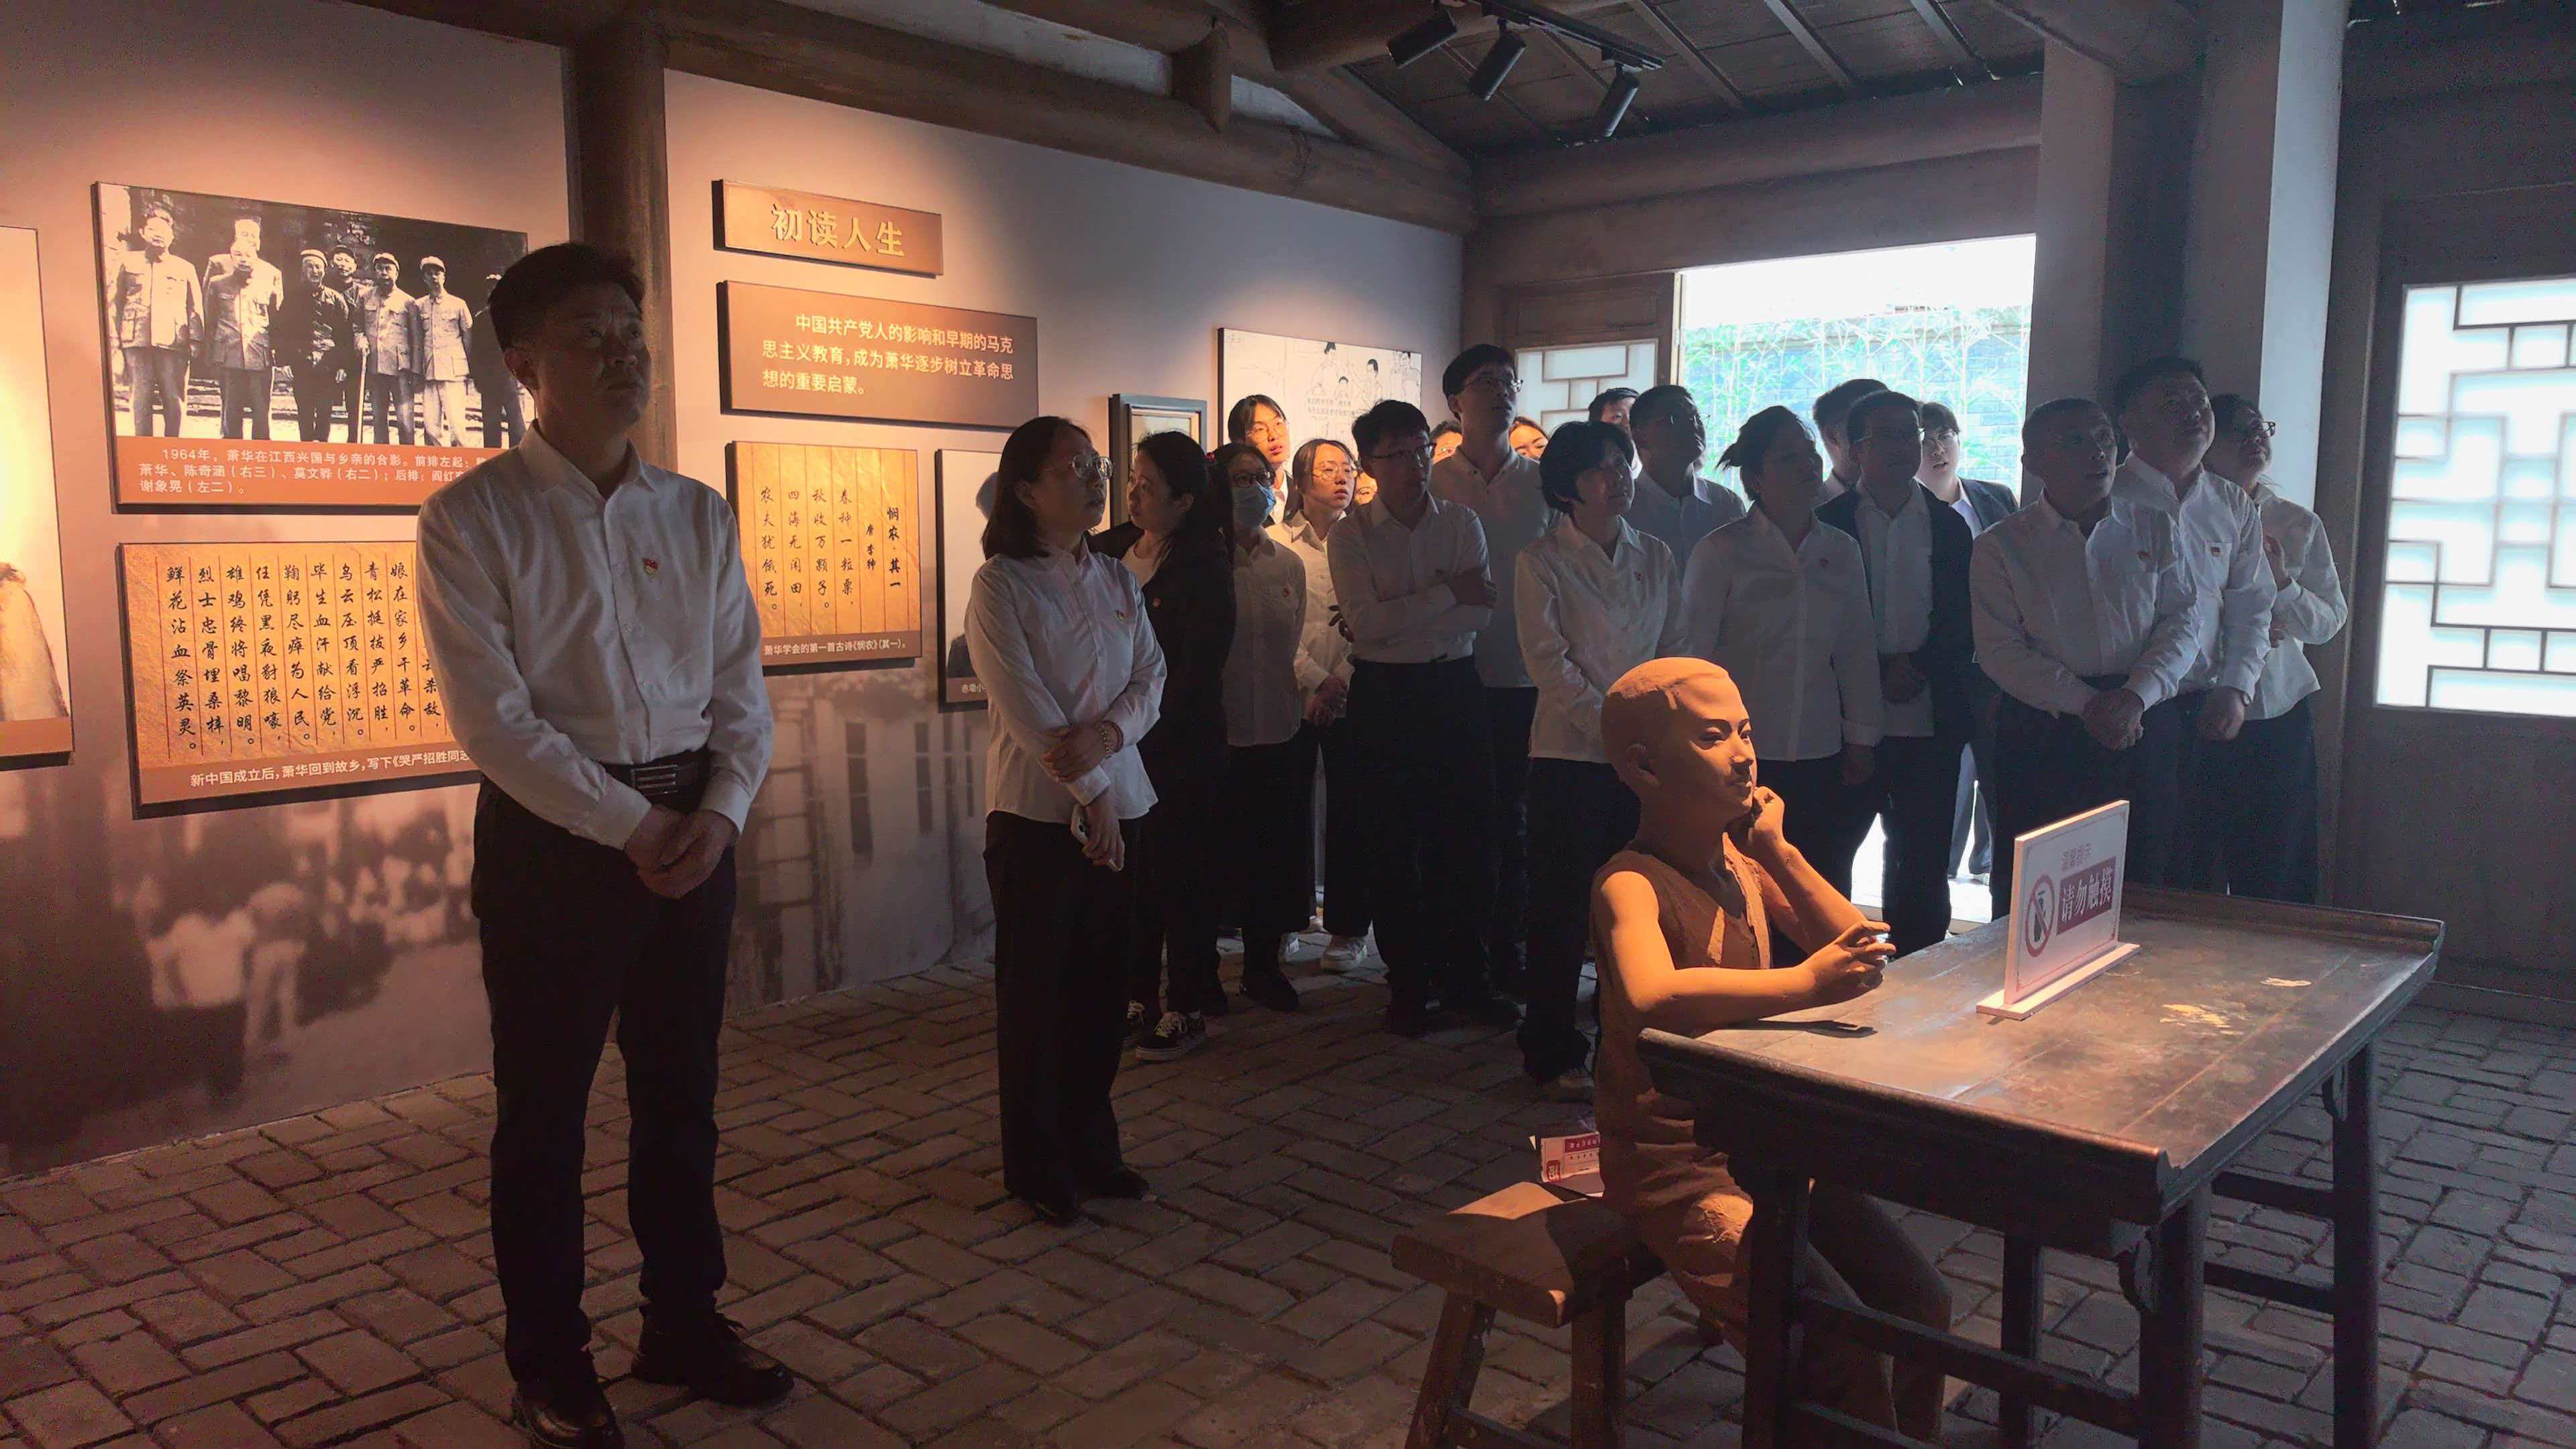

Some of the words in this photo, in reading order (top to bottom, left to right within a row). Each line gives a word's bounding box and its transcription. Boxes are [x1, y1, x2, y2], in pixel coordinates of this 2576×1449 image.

[771, 204, 905, 258] 初读人生
[761, 340, 1014, 380] 思主义教育，成为萧华逐步树立革命思
[795, 313, 1014, 355] 中国共产党人的影响和早期的马克
[762, 370, 865, 395] 想的重要启蒙。
[760, 486, 777, 610] 农夫犹饿死。
[812, 489, 830, 609] 秋收万颗子。
[865, 523, 875, 536] 唐
[866, 544, 877, 571] 李绅
[166, 566, 197, 750] 鲜花沾血祭英灵。
[226, 564, 254, 745] 雄鸡终将唱黎明。
[284, 564, 311, 741] 鞠躬尽瘁为人民。
[339, 563, 364, 737] 乌云压顶看浮沉。
[390, 562, 415, 732] 娘在家乡干革命。
[2061, 865, 2114, 923] 请勿触摸
